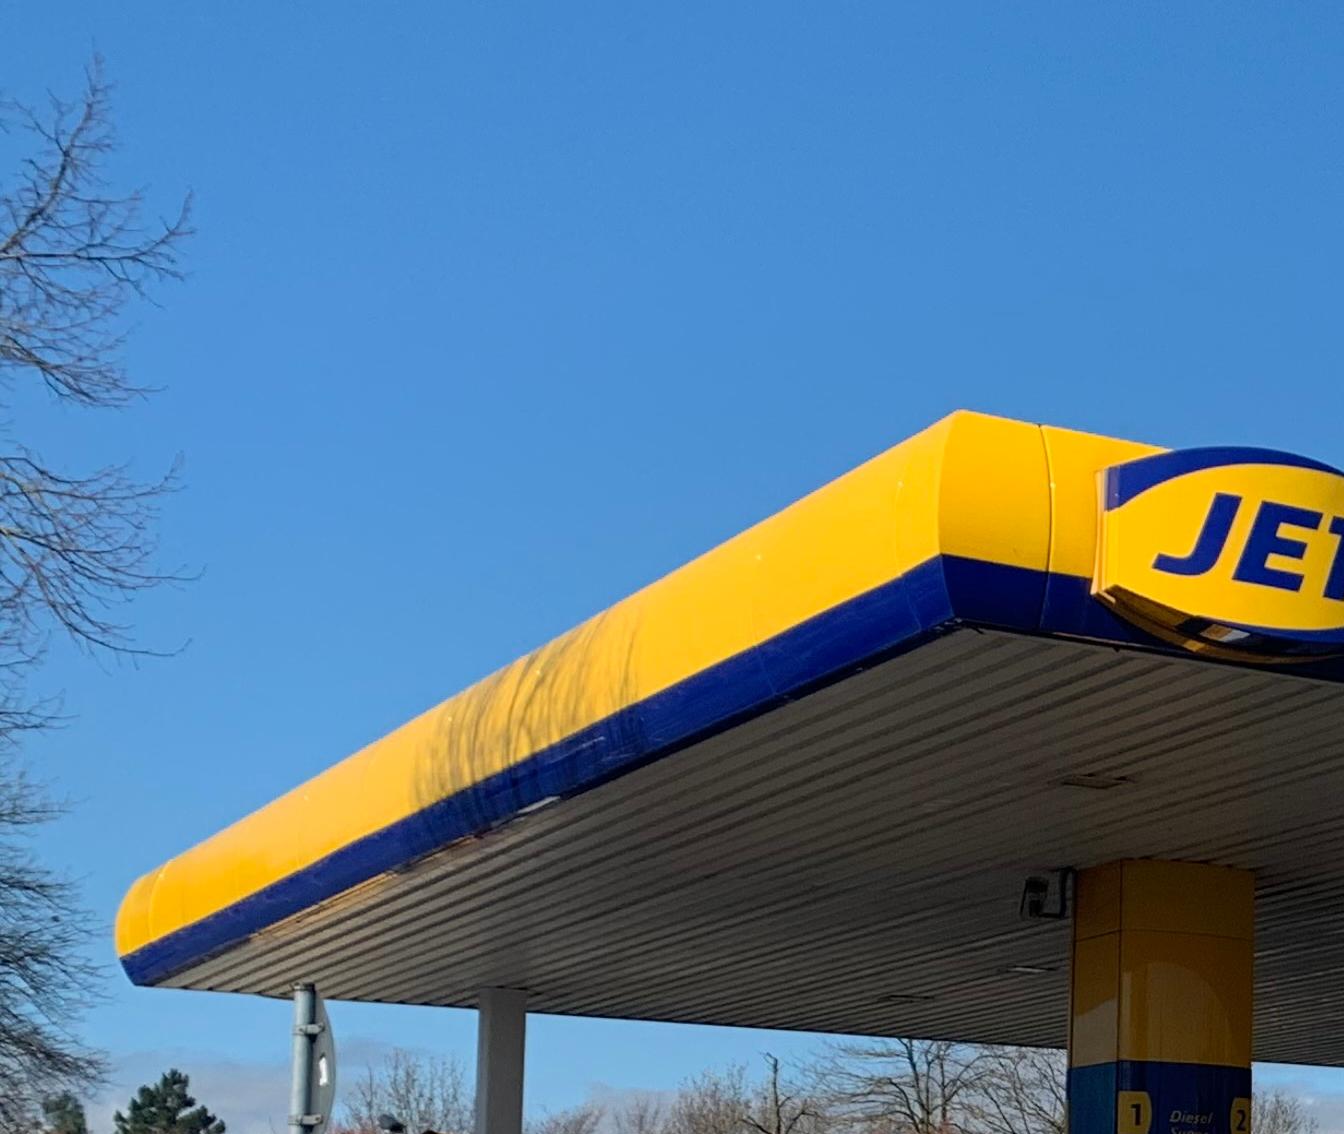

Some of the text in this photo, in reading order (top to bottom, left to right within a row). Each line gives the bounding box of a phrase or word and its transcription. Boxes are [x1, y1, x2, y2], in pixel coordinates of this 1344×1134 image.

[1130, 1103, 1141, 1126] 1
[1169, 1110, 1214, 1125] Diesel
[1236, 1109, 1246, 1132] 2
